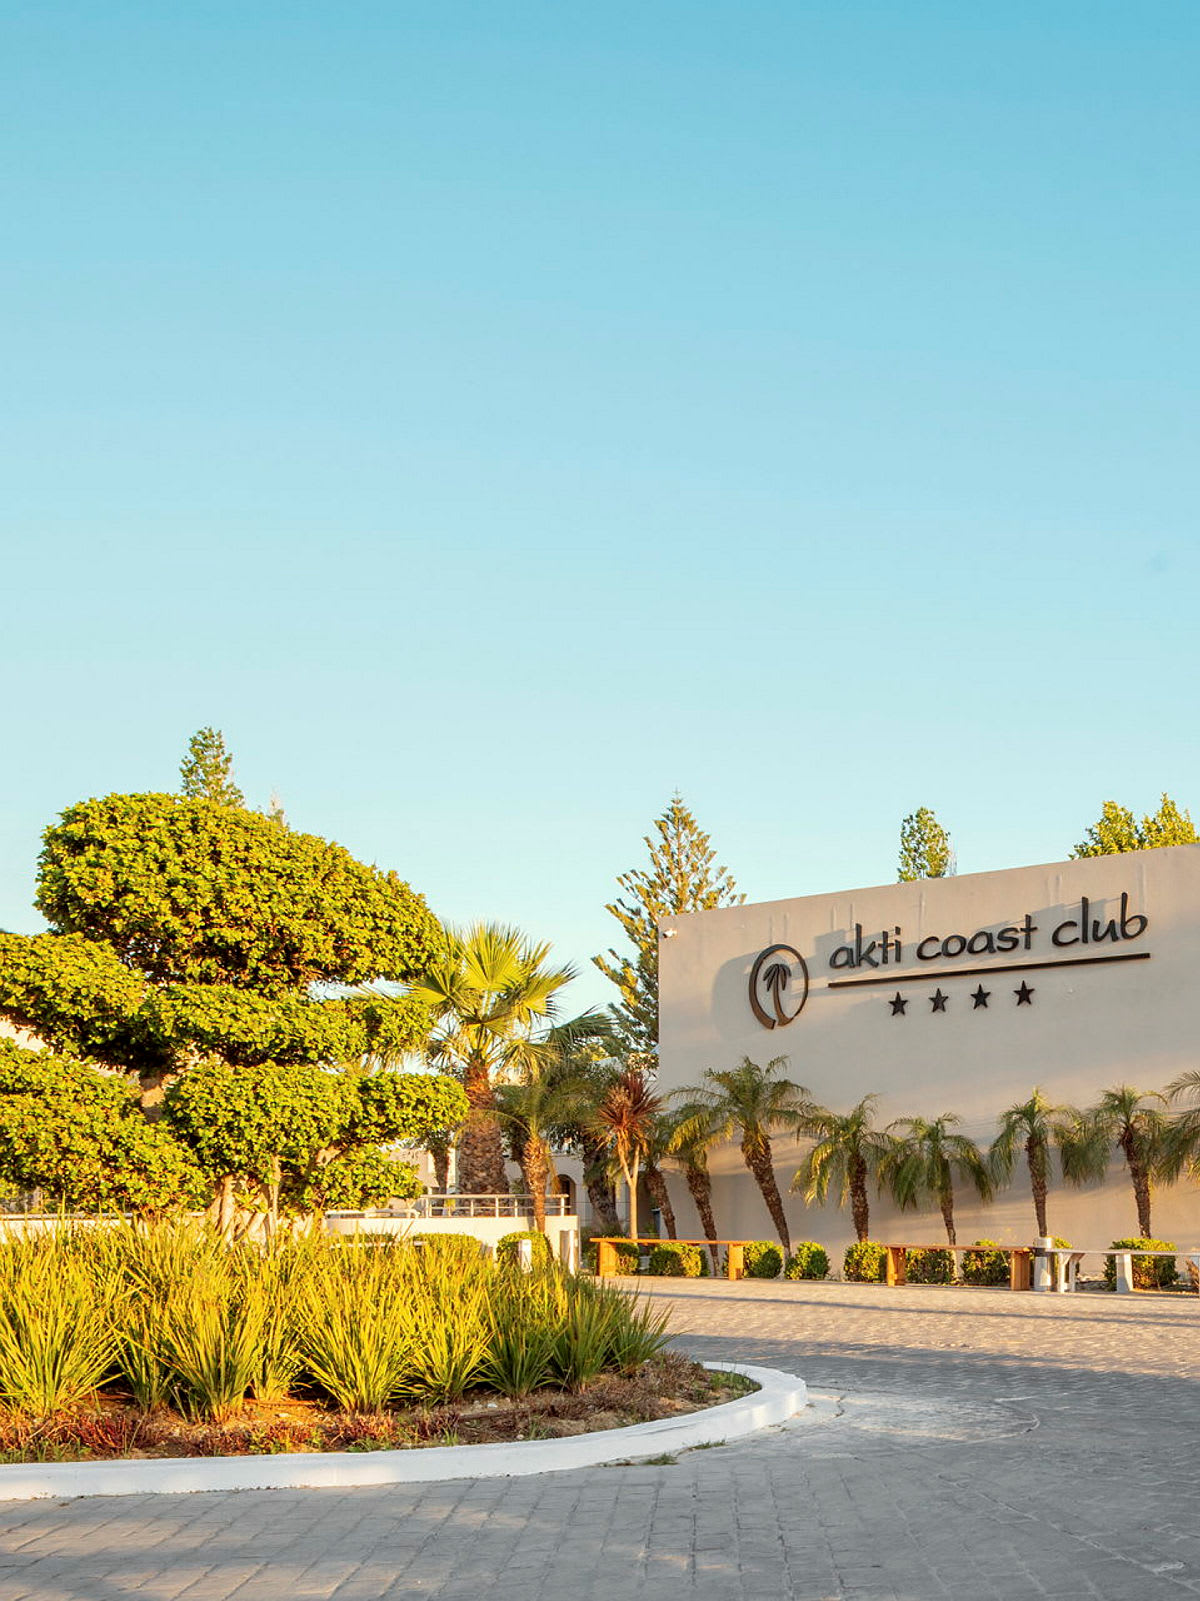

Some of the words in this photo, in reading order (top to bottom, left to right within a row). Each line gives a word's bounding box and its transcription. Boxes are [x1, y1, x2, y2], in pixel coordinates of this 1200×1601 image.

[829, 923, 902, 969] akti
[916, 914, 1039, 961] coast
[1051, 892, 1149, 948] club
